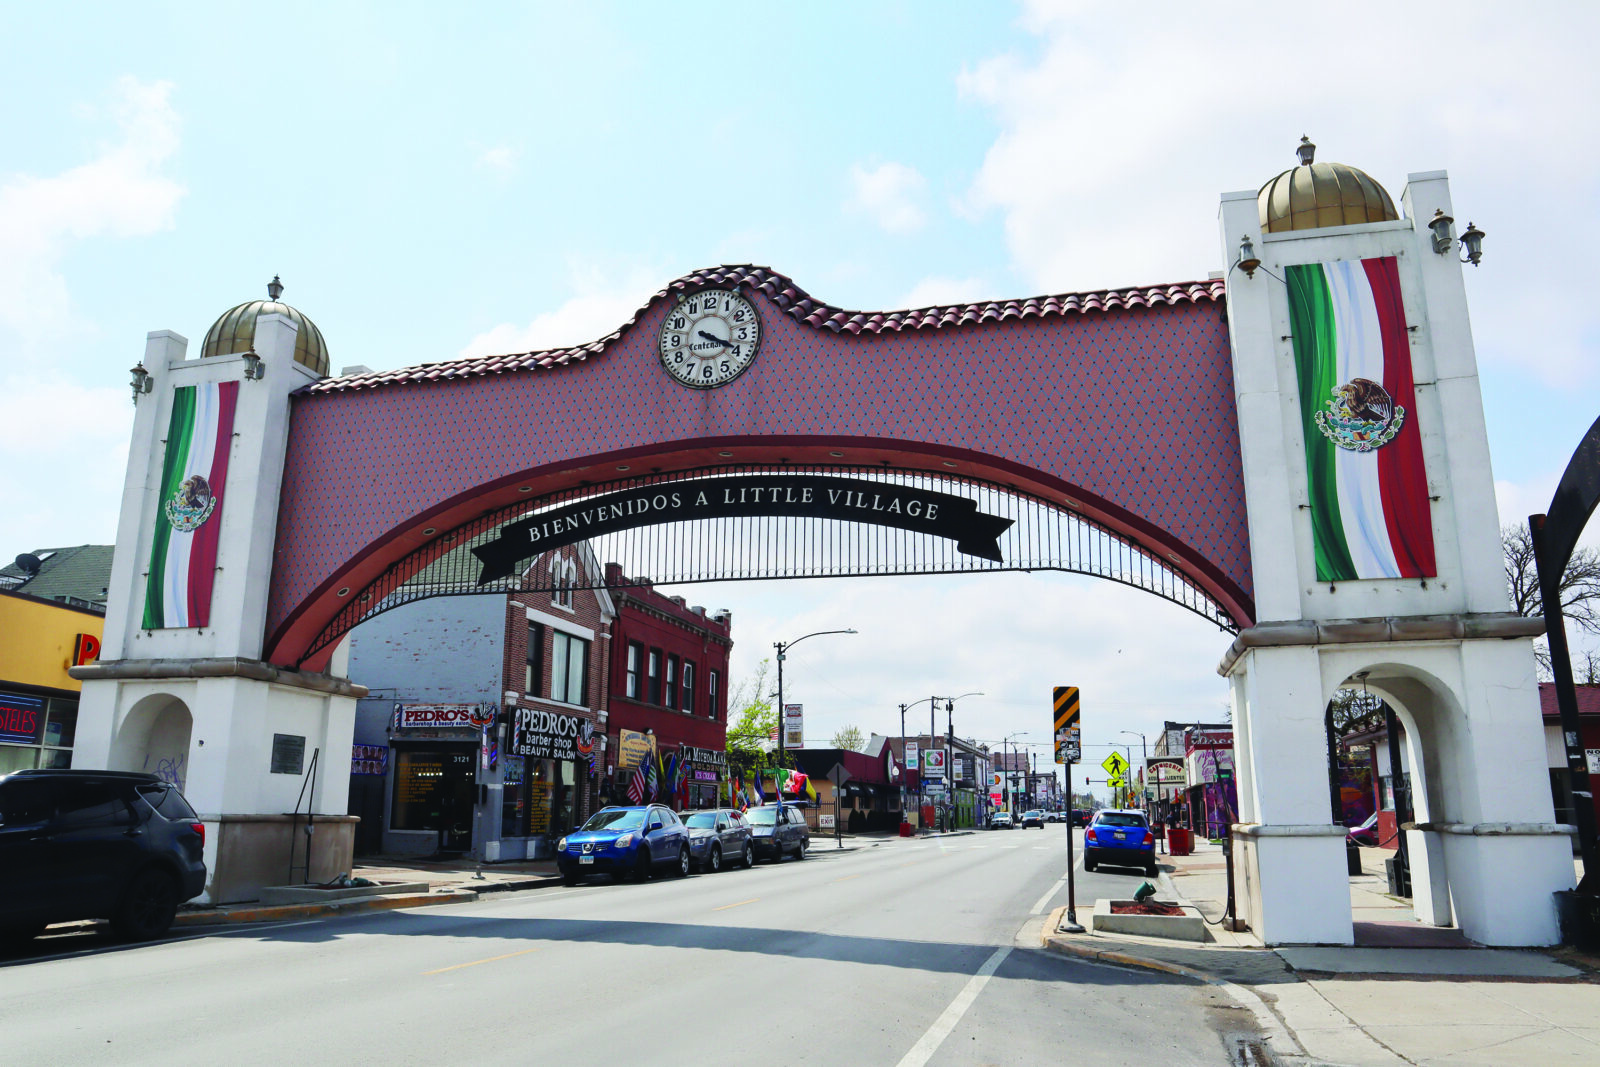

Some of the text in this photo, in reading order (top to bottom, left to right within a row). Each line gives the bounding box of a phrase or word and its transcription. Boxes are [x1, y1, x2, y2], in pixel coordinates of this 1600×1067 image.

[688, 302, 698, 315] 11
[704, 297, 717, 310] 12
[725, 300, 730, 312] 1
[734, 310, 745, 323] 2
[673, 317, 686, 330] 10
[738, 327, 748, 340] 3
[671, 335, 680, 347] 9
[731, 344, 741, 357] 4
[674, 351, 684, 364] 8
[686, 362, 696, 376] 7
[703, 365, 713, 379] 6
[720, 360, 730, 373] 5
[528, 487, 939, 542] BIENVENIDOS A LITTLE VILLAGE
[404, 709, 470, 722] PEDRO'S
[520, 708, 579, 738] PEDRO'S
[525, 731, 573, 750] barber shop
[453, 755, 470, 763] 3121
[520, 745, 576, 760] BEAUTY SALON
